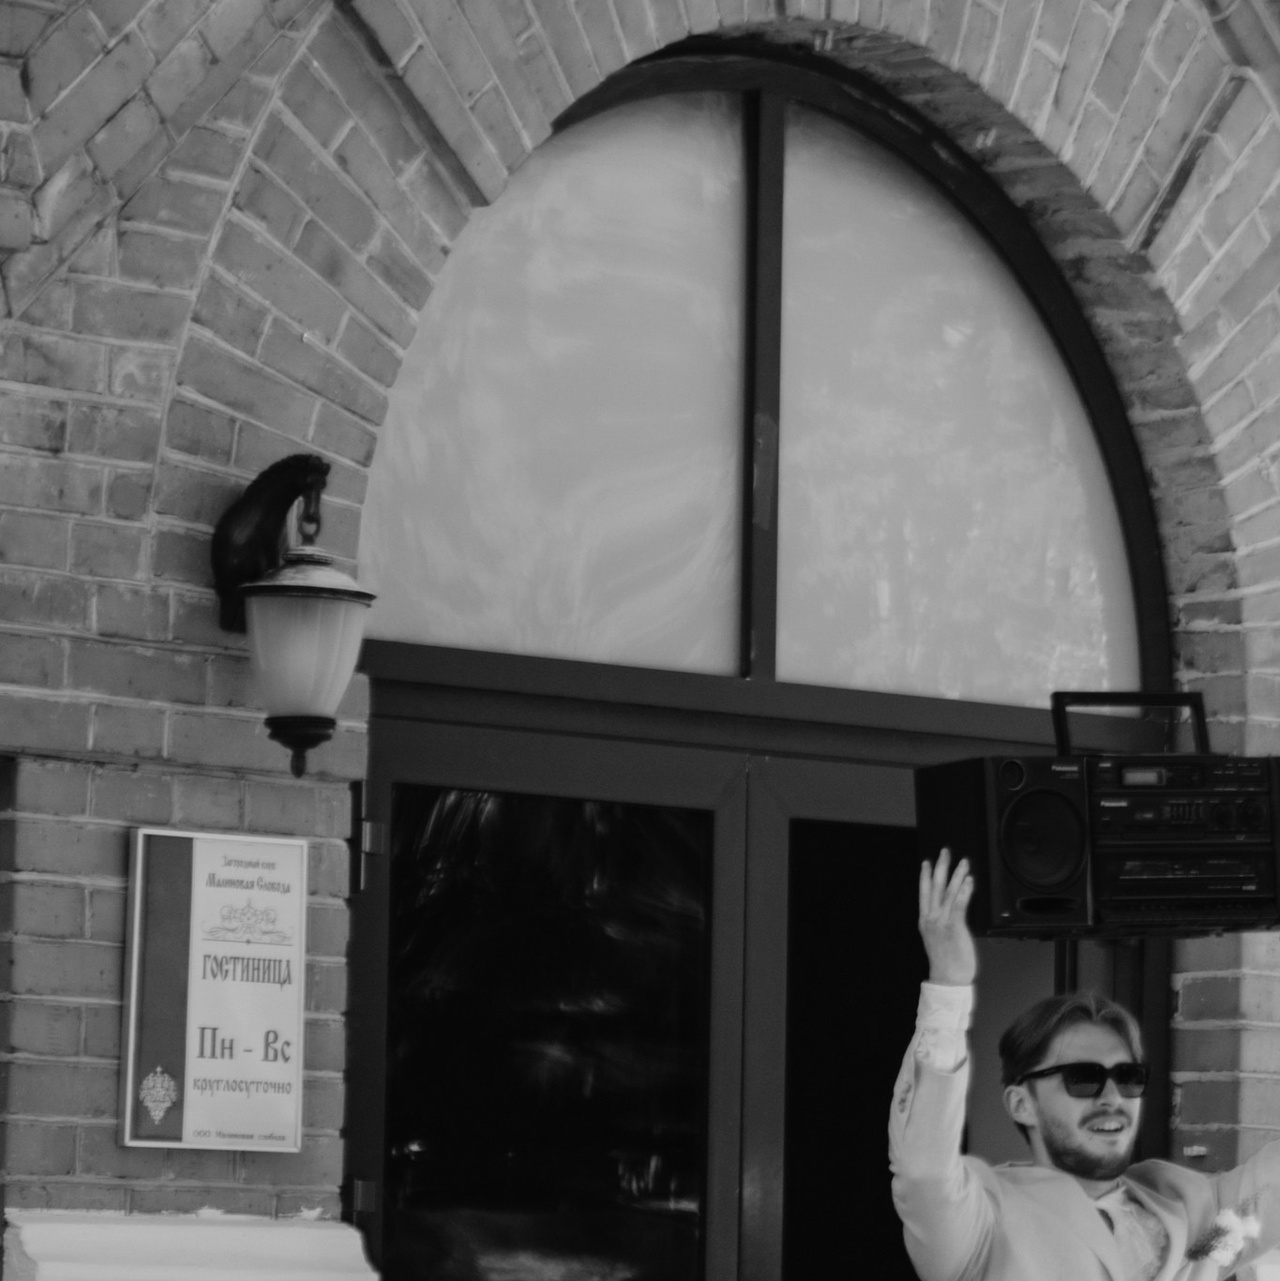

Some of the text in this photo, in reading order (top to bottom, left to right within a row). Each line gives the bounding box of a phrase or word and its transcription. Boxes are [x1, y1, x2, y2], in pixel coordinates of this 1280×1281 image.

[205, 872, 291, 894] Малиновая Слобода
[201, 953, 292, 991] ГОСТИНИЦА
[195, 1026, 234, 1060] Пн
[261, 1030, 292, 1064] Вс
[191, 1077, 292, 1100] круглосуточно
[192, 1129, 211, 1139] ООО
